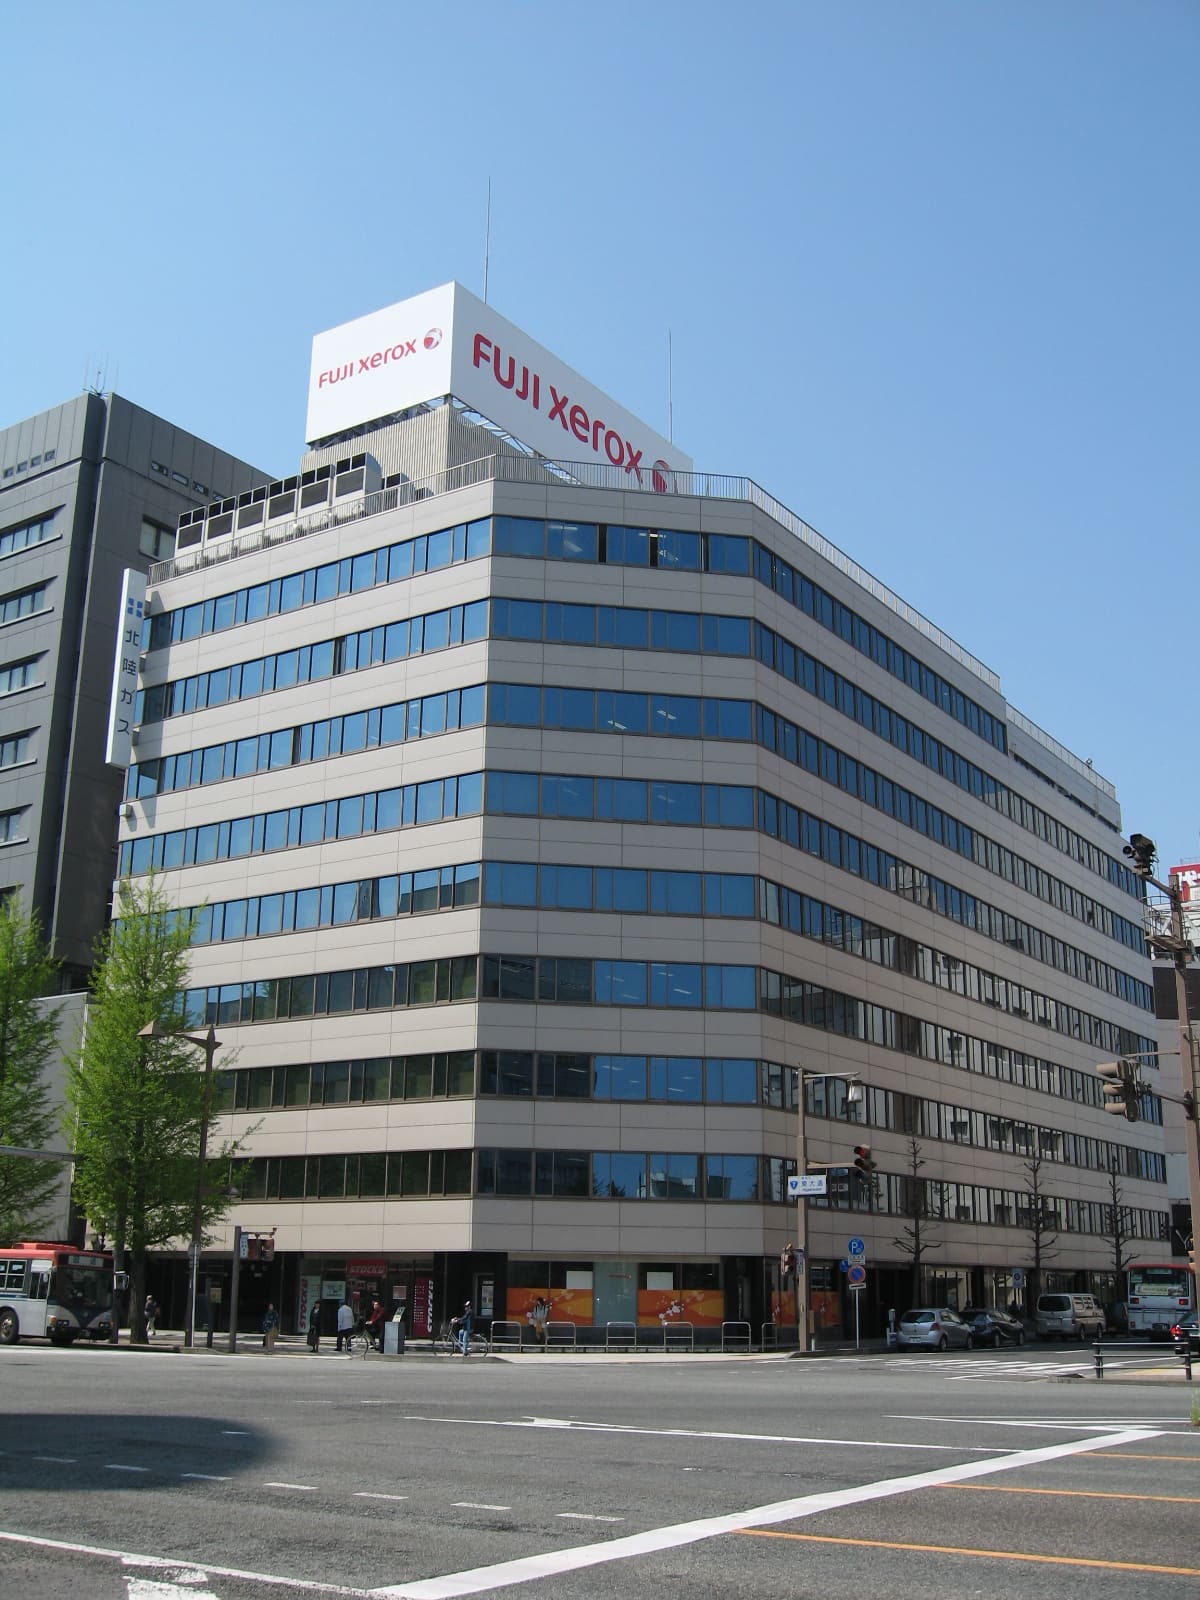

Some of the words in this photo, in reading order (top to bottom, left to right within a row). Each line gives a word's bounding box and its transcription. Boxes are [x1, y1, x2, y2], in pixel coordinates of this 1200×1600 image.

[318, 362, 354, 389] FUJI
[358, 338, 417, 374] xerox
[472, 332, 540, 411] FUJI
[548, 384, 644, 487] xerox
[117, 628, 140, 736] 北陸ガス
